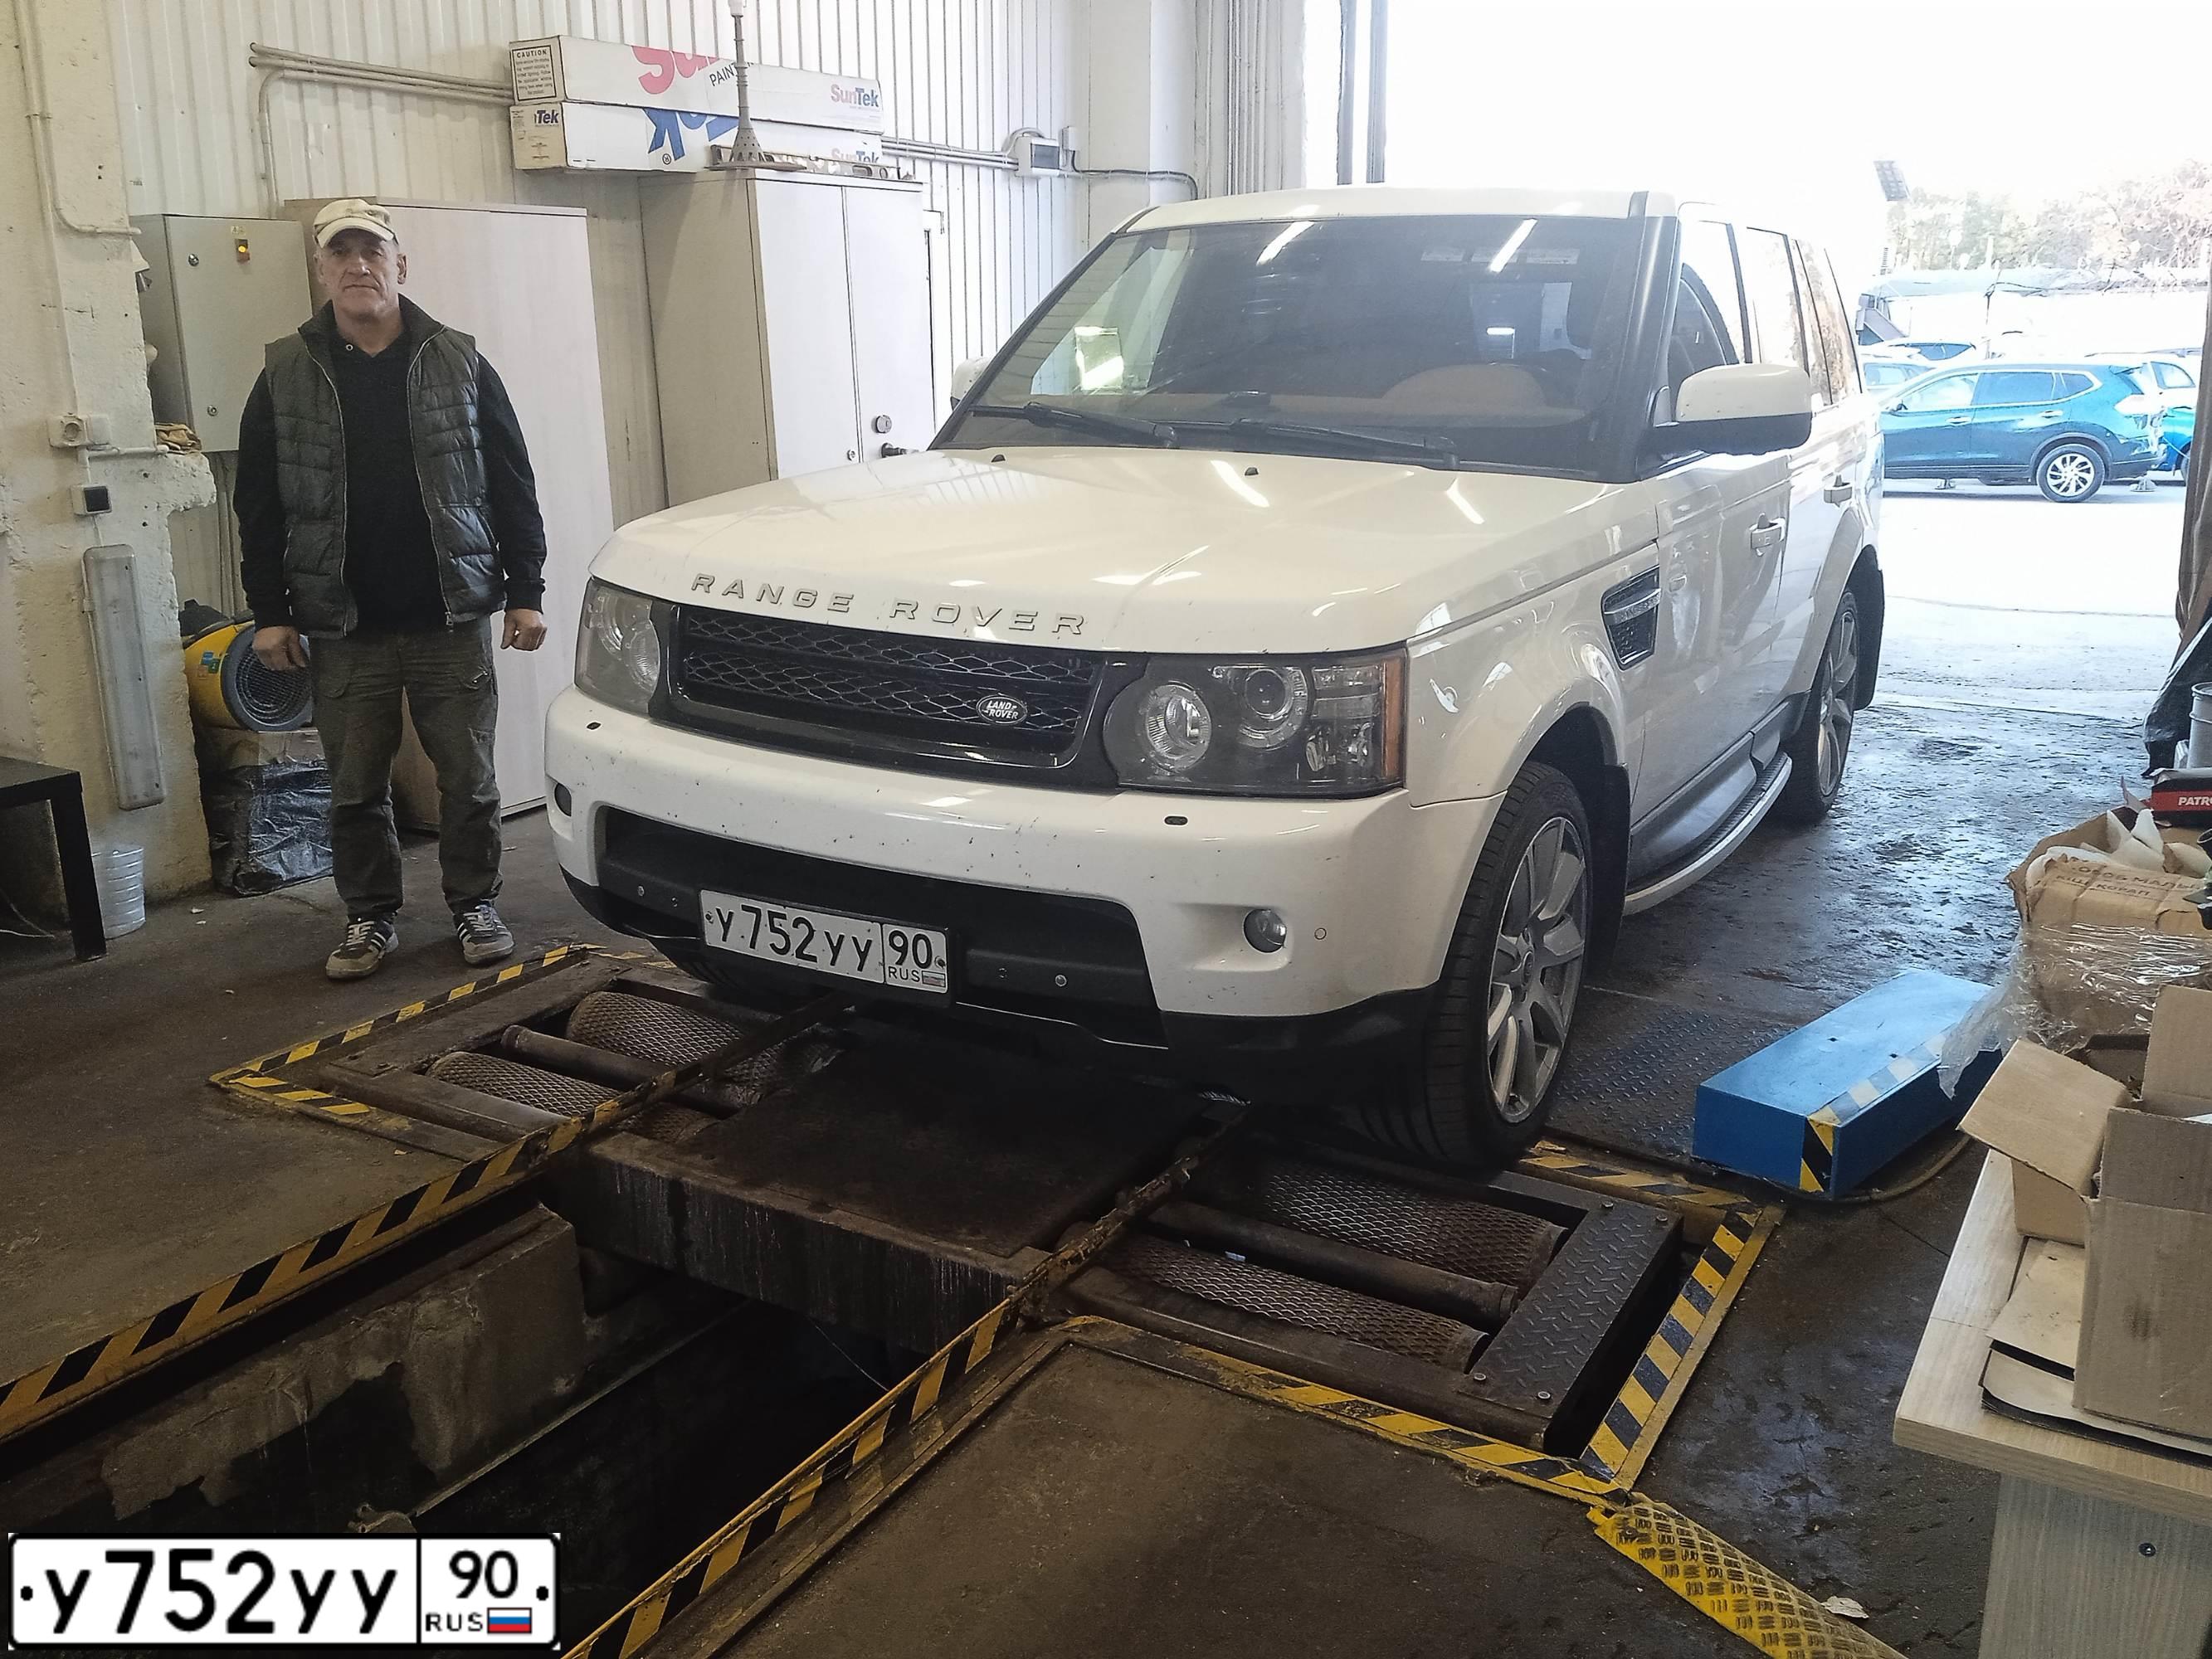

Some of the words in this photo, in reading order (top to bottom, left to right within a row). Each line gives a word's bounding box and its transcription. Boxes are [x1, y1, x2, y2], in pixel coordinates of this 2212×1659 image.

[516, 50, 548, 58] CAUTION
[831, 84, 879, 108] SunTek
[691, 572, 855, 613] RANGE
[889, 598, 1085, 635] ROVER
[889, 930, 933, 969] 90
[888, 967, 920, 982] RUS
